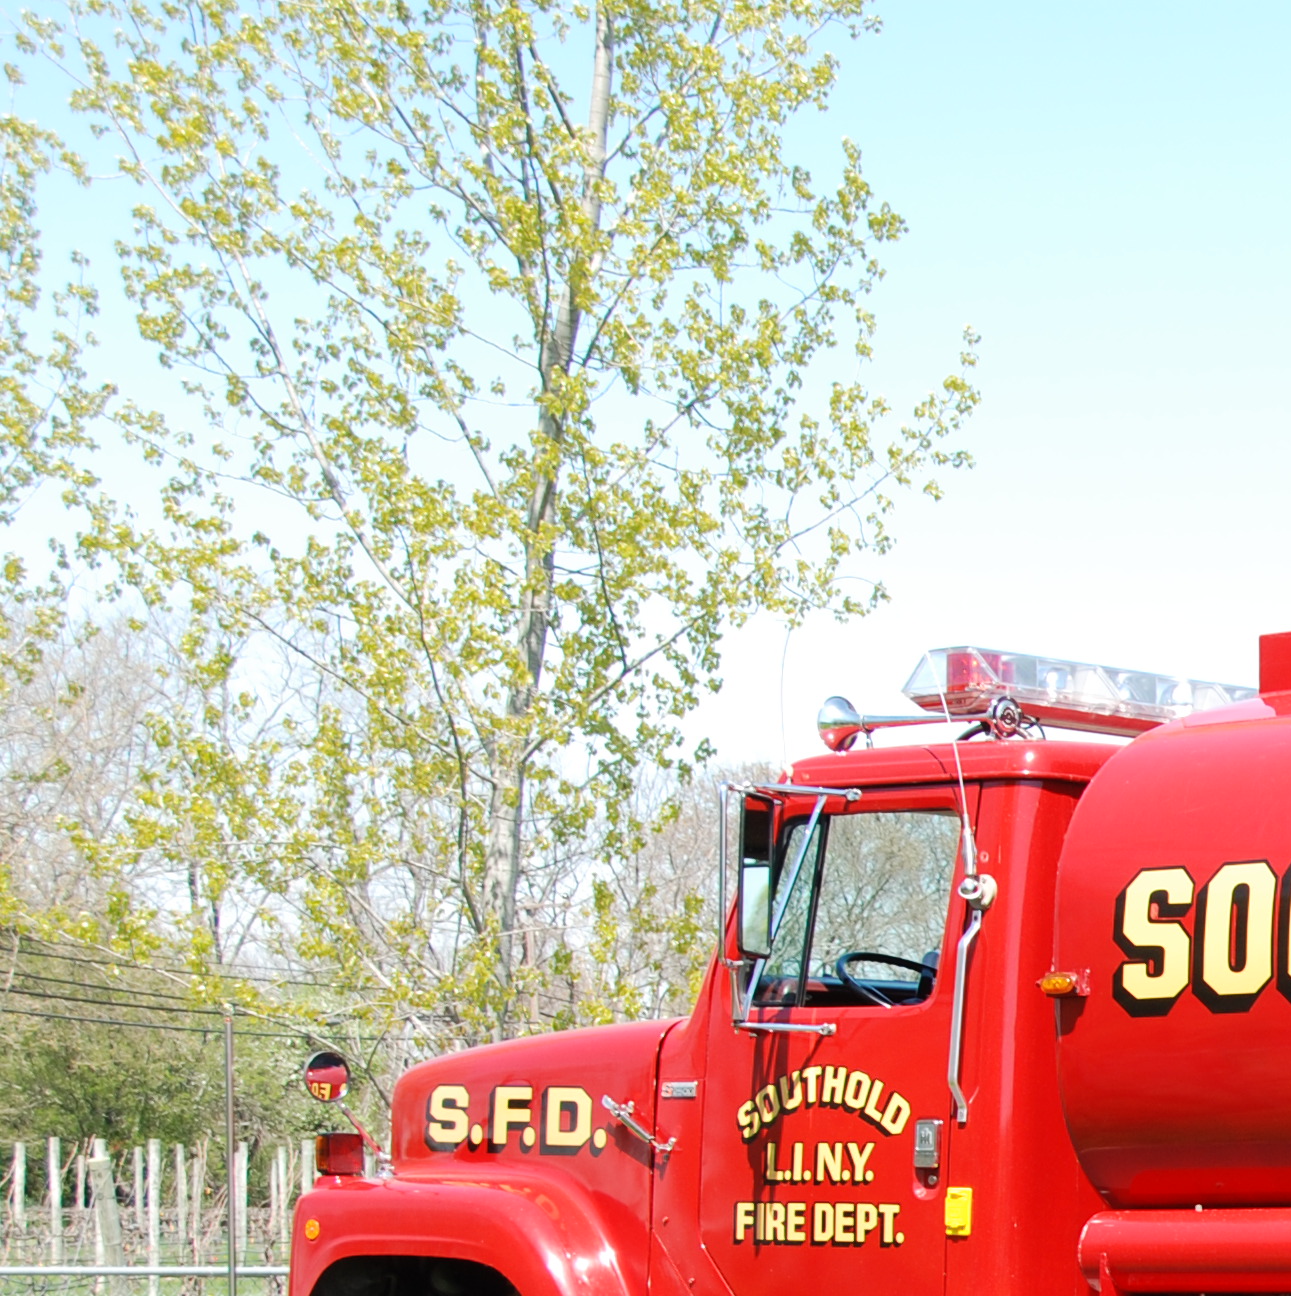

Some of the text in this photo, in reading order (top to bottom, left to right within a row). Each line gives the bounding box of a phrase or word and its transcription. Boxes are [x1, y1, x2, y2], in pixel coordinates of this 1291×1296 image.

[427, 1085, 608, 1155] S.F.D.
[737, 1066, 911, 1141] SOUTHOLD
[735, 1202, 905, 1245] FIRE DEPT.
